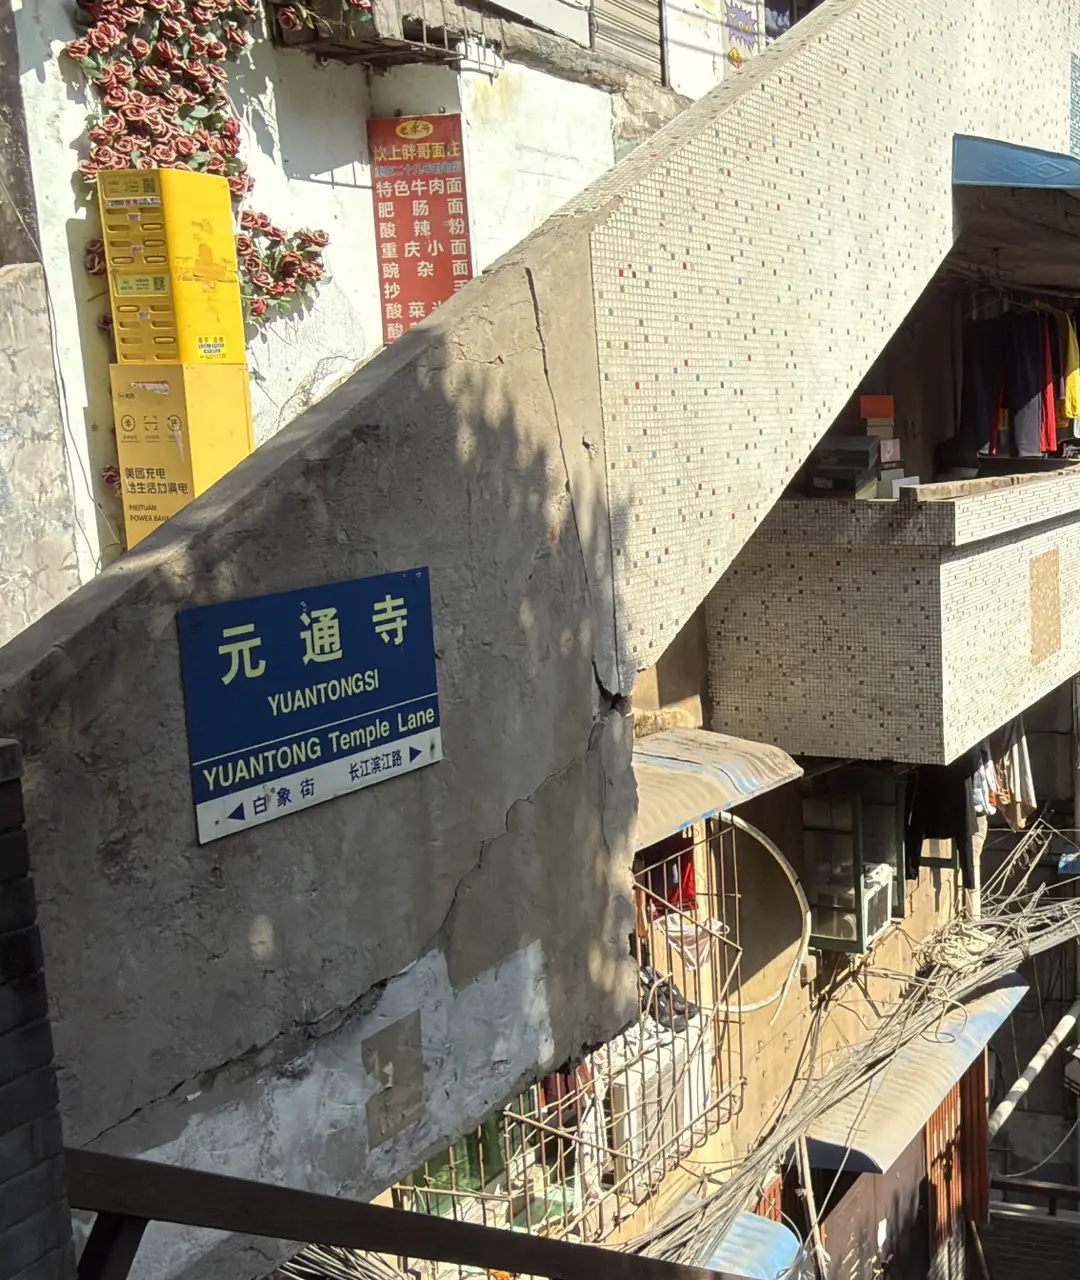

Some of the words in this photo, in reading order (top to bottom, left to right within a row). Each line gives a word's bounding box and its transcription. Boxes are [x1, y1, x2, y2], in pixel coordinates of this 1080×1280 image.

[376, 177, 462, 198] 特色牛肉面
[381, 239, 467, 259] 重庆小面
[125, 468, 166, 480] 美团充电
[129, 504, 157, 512] MEITUAN
[130, 514, 153, 522] POWER
[218, 594, 408, 686] 元通寺
[267, 668, 379, 717] YUANTONGSI
[203, 736, 321, 792] YUANTONG
[328, 719, 390, 753] Temple
[398, 707, 435, 733] Lane
[348, 749, 403, 782] 长江滨江路
[252, 777, 316, 816] 白象街
